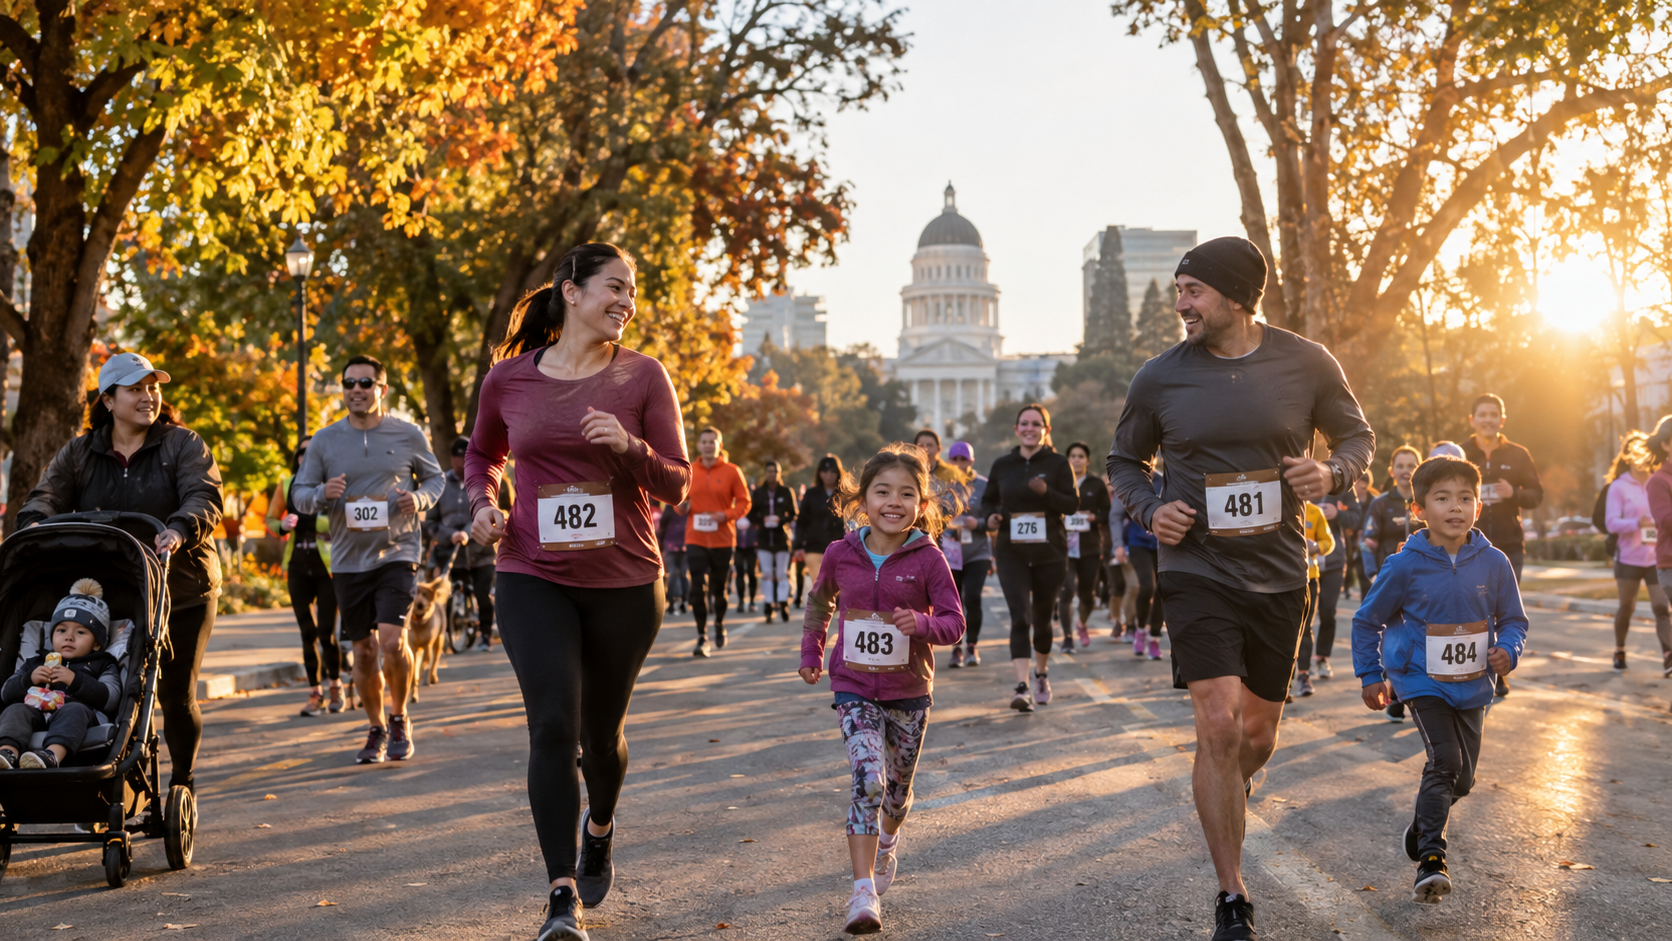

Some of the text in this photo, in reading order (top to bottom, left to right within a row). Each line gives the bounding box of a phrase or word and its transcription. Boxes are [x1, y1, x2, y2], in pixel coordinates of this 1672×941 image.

[354, 506, 378, 521] 302
[554, 503, 597, 529] 482
[1224, 491, 1263, 517] 481
[1017, 522, 1037, 535] 276
[855, 631, 893, 655] 483
[1441, 641, 1477, 665] 484
